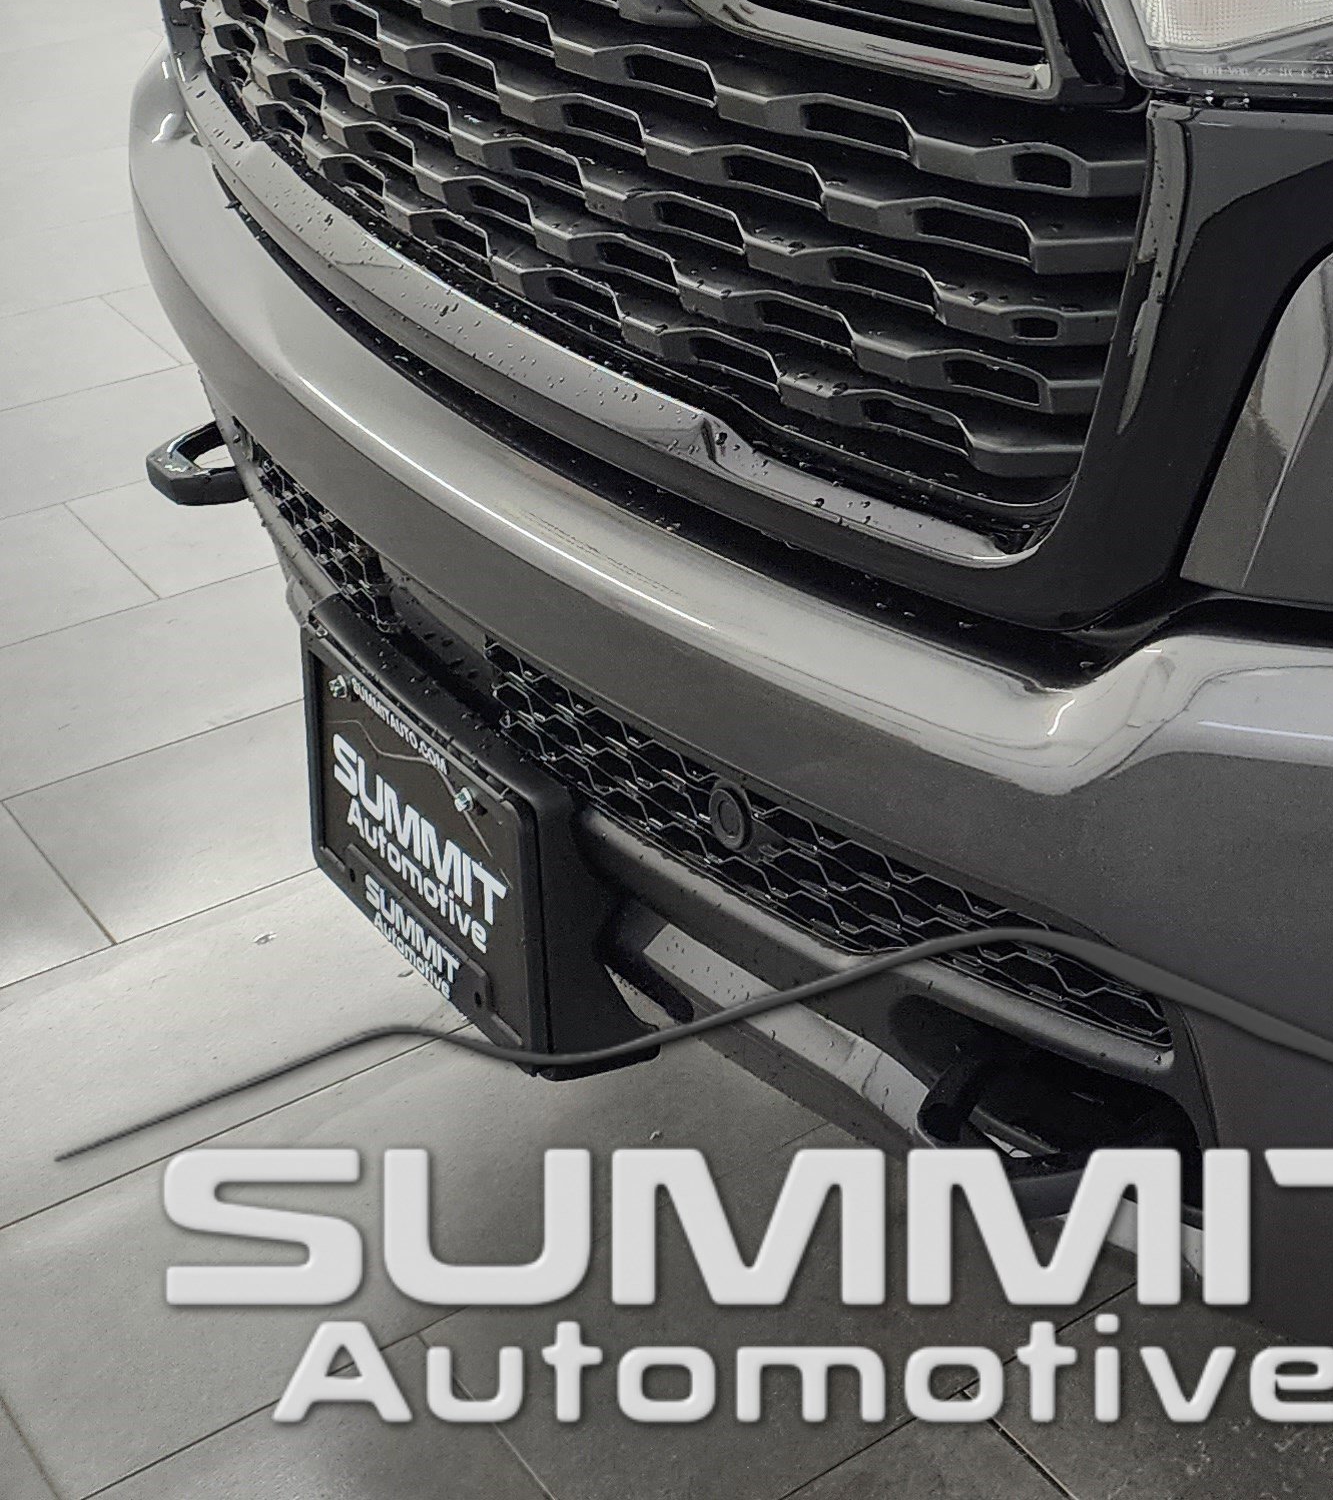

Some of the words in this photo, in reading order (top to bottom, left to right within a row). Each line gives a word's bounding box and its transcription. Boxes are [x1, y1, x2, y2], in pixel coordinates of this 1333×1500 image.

[332, 733, 507, 926] SUMMIT
[346, 798, 488, 954] Automotive
[365, 873, 461, 983] SUMMIT
[373, 911, 451, 1000] Automotive
